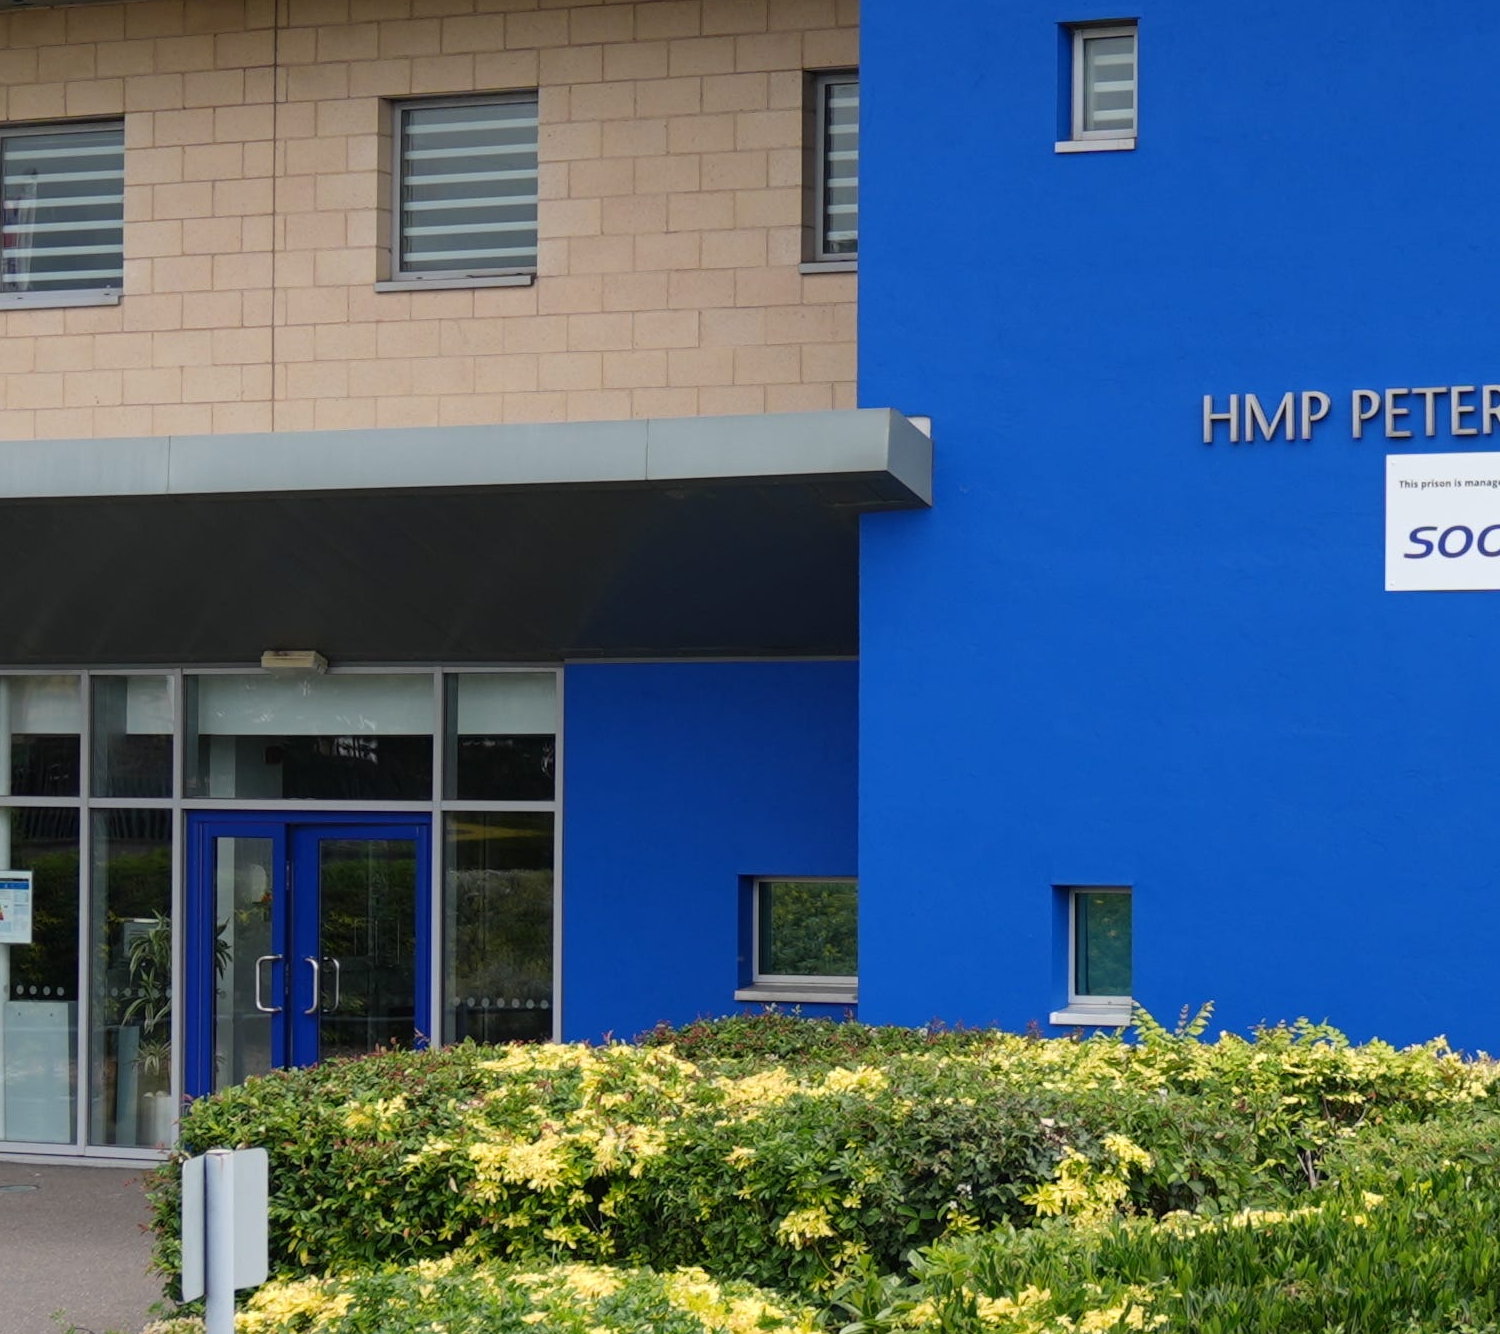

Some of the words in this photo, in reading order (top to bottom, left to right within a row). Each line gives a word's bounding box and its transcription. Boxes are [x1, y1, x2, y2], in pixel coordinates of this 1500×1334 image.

[1202, 390, 1331, 443] HMP
[1399, 479, 1418, 489] This
[1421, 479, 1451, 490] prison
[1454, 478, 1462, 488] is
